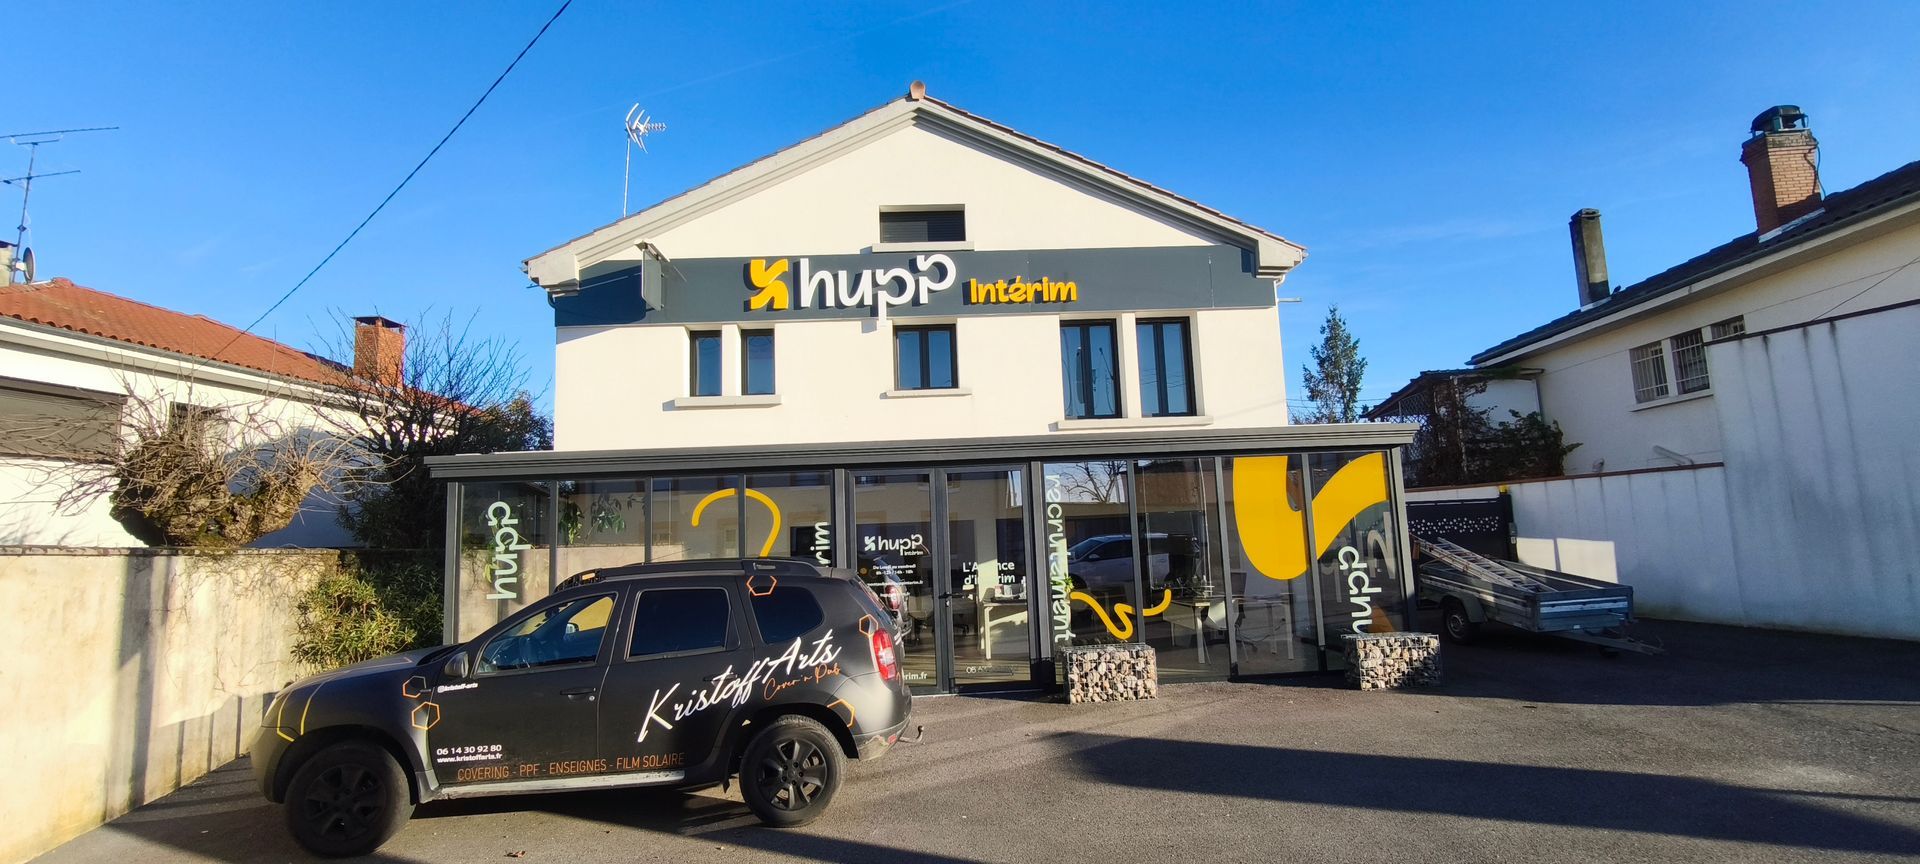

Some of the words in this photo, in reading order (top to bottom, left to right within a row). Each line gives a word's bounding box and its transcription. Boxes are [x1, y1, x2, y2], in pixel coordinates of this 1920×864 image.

[800, 253, 957, 326] hupp
[969, 275, 1077, 304] Intérim
[486, 501, 532, 600] hupp
[878, 533, 923, 556] hupp
[962, 561, 1015, 572] L'Ance
[1045, 474, 1077, 643] recrutement
[436, 747, 449, 756] 06
[451, 746, 462, 755] 14
[463, 745, 476, 754] 30
[476, 745, 489, 753] 92
[490, 744, 503, 752] 80
[436, 752, 503, 764] www.kristoffarts.fr
[457, 766, 509, 782] COVERING
[519, 763, 541, 777] PPF
[550, 758, 607, 775] ENSEIGNES
[616, 755, 641, 771] FILM
[642, 752, 685, 768] SOLAIRE
